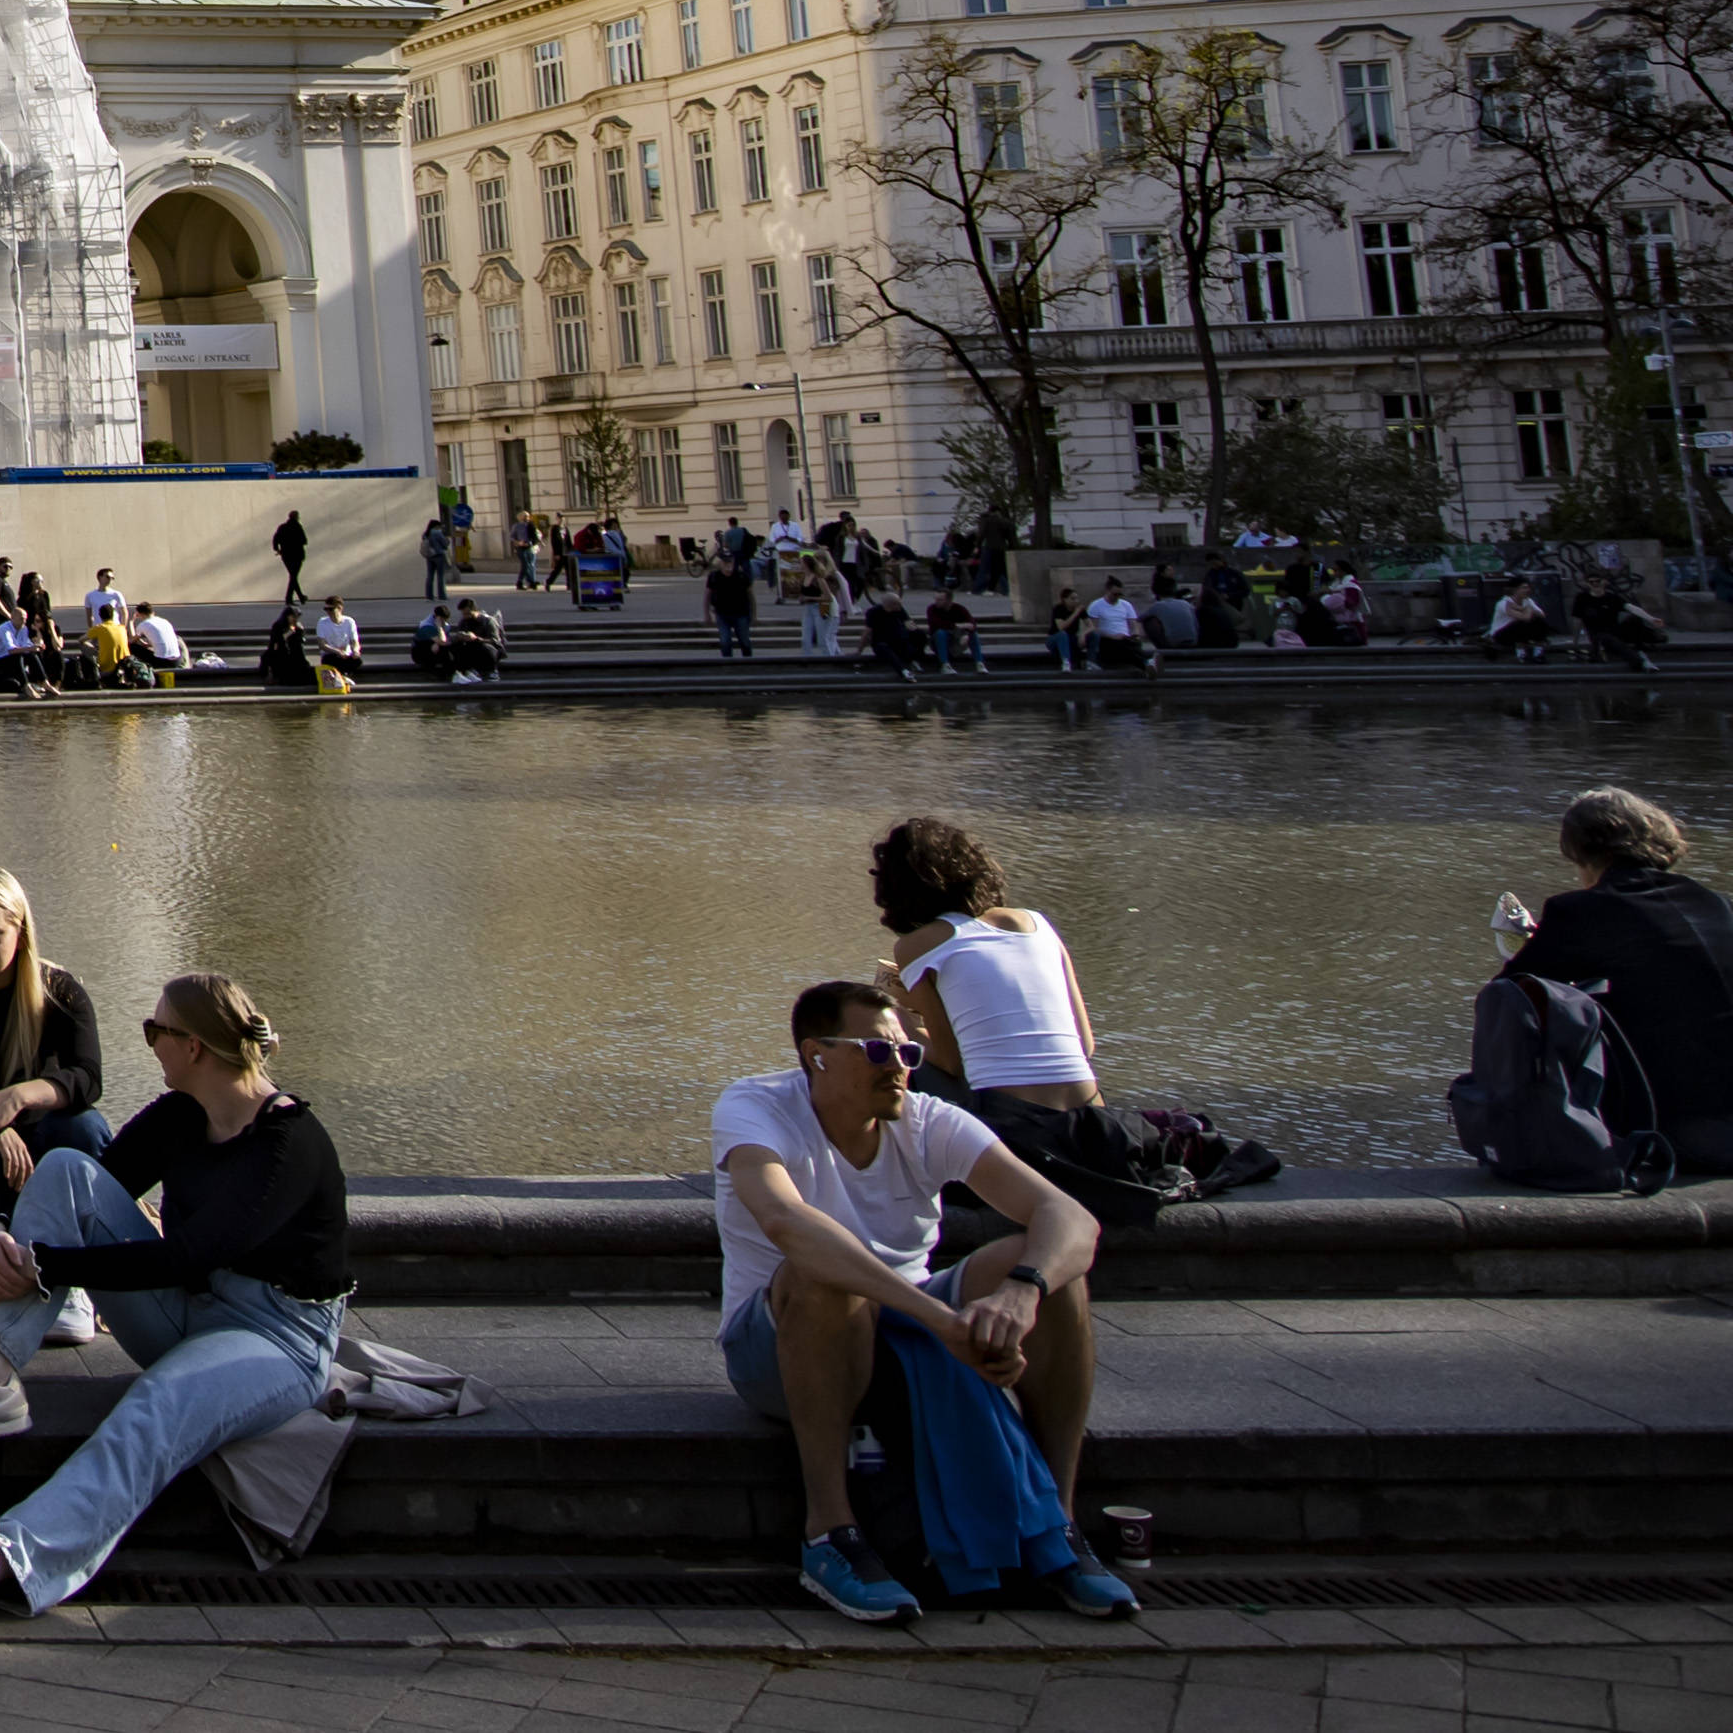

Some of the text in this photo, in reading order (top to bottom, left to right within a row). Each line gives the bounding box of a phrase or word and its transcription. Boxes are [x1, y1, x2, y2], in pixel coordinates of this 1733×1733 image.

[153, 331, 182, 339] KARLS
[153, 339, 186, 347] KIRCHE
[155, 354, 251, 363] EINGANG ENTRANCE
[63, 465, 226, 477] www.containex.com
